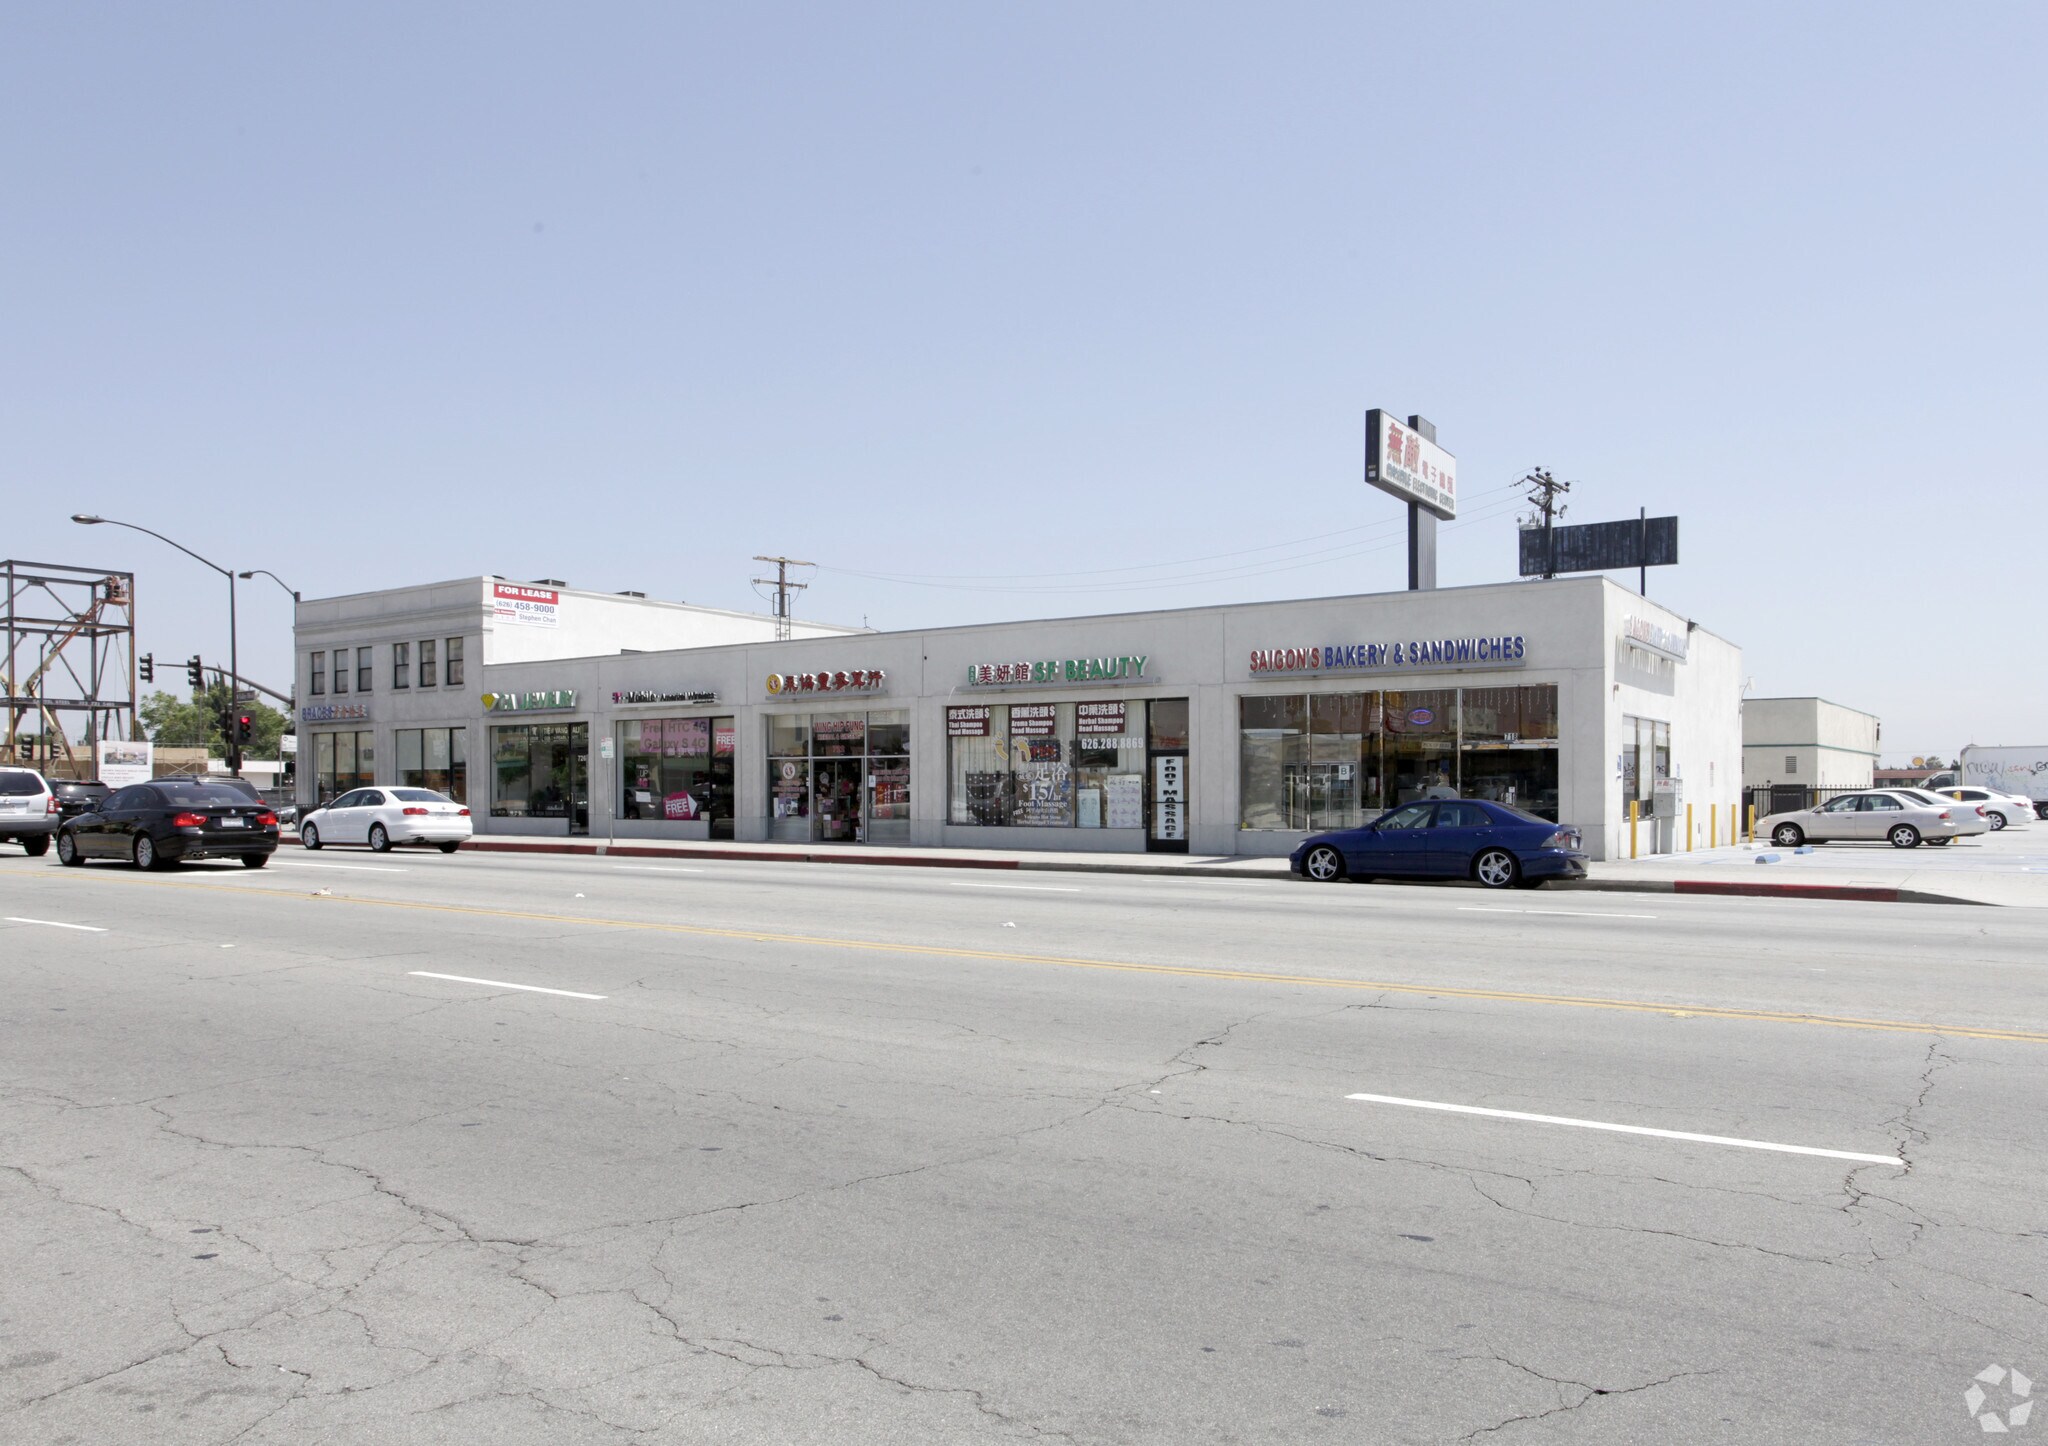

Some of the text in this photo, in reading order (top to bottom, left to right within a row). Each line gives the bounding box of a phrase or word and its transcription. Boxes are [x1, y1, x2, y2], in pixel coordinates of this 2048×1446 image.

[498, 586, 553, 599] FOR LEASE
[496, 600, 513, 608] (626)
[514, 602, 555, 613] 458-9000
[519, 614, 542, 622] Stephen
[1250, 635, 1526, 671] SAIGON'S BAKERY & SANDWICHES
[1034, 656, 1147, 681] SF BEAUTY
[668, 722, 690, 733] HTC
[693, 721, 707, 732] 4G
[1098, 717, 1124, 725] Shampoo
[682, 739, 689, 748] S
[691, 738, 706, 748] 4G
[716, 736, 735, 745] FREE
[1081, 738, 1144, 749] 626.288.8869
[1164, 759, 1177, 786] FOOT
[666, 801, 689, 815] FREE
[1036, 800, 1067, 808] Massage
[1163, 790, 1178, 838] MASSAGE
